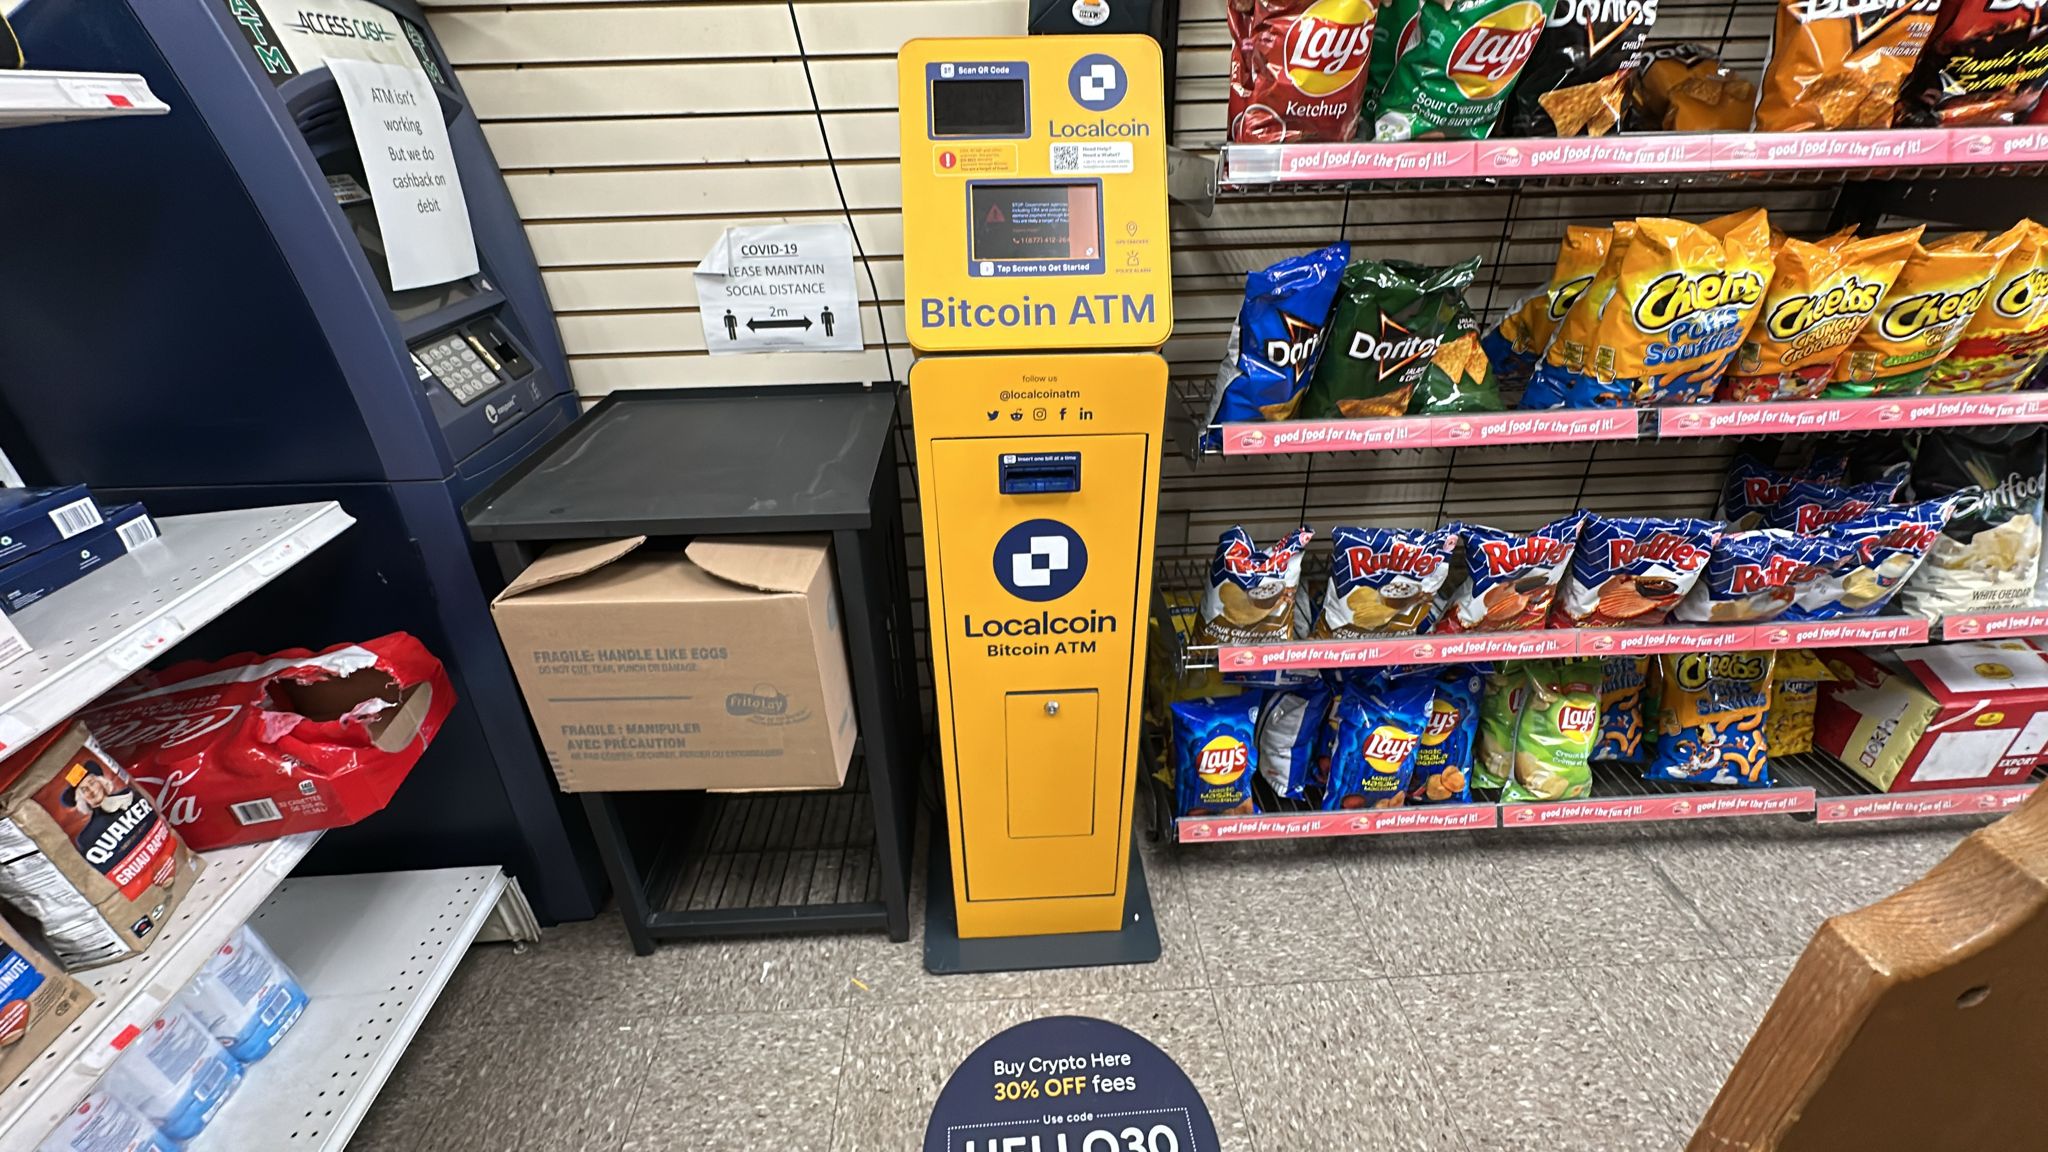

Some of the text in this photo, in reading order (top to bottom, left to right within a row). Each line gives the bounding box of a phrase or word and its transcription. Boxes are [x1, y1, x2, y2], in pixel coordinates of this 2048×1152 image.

[298, 10, 386, 43] ACCESS CASH
[1290, 17, 1374, 75] Lay's
[1452, 23, 1540, 81] Lay's
[958, 66, 1009, 75] Scan QR Code
[371, 88, 417, 106] ATM isn't
[1416, 91, 1445, 110] Sour
[1446, 102, 1484, 116] Cream
[1285, 100, 1348, 119] Ketchup
[383, 117, 423, 135] working
[1049, 118, 1150, 138] Localcoin
[388, 146, 435, 161] But we do
[1768, 140, 1920, 160] good food for the fun of it!
[1291, 151, 1447, 171] good food for the fun of it!
[393, 172, 446, 188] cashback on
[417, 199, 441, 213] debit
[741, 243, 798, 256] COVID-19
[728, 264, 825, 278] LEASE MAINTAIN
[997, 263, 1090, 273] Tap Screen to Get Started
[726, 283, 826, 297] SOCIAL DISTANCE
[769, 306, 788, 317] 2m
[921, 294, 1156, 328] Bitcoin ATM
[1767, 276, 1882, 341] Cheetos
[1022, 375, 1046, 383] follow
[1000, 389, 1080, 401] @localcoinatm
[1274, 428, 1408, 447] good food for the fun of it!
[1346, 542, 1445, 580] Ruffles
[1480, 536, 1575, 577] Ruffles
[1608, 531, 1711, 572] Ruffles
[1973, 588, 2031, 600] WHITE CHEDDAR
[964, 609, 1117, 638] Localcoin
[987, 641, 1096, 657] Bitcoin ATM
[1621, 634, 1735, 650] good food for the fun of it!
[533, 647, 729, 663] FRAGILE: HANDLE LIKE EGGS
[1676, 653, 1764, 692] Cheetos
[1561, 705, 1596, 732] Lay's
[561, 722, 701, 736] FRAGILE MANIPULER
[567, 739, 600, 751] AVEC
[1365, 734, 1418, 763] Lay's
[1199, 742, 1246, 775] Lay's
[1998, 757, 2038, 768] EXPORT
[86, 798, 153, 864] QUAKER
[1218, 824, 1237, 836] good
[1239, 823, 1257, 834] food
[1259, 822, 1270, 833] for
[1272, 823, 1285, 832] the
[1286, 824, 1300, 834] fun
[1302, 822, 1311, 834] of
[116, 850, 151, 886] GRUAU
[994, 1052, 1131, 1078] Buy Crypto Here
[994, 1074, 1136, 1101] 30% OFF fees
[1043, 1112, 1094, 1125] Use code
